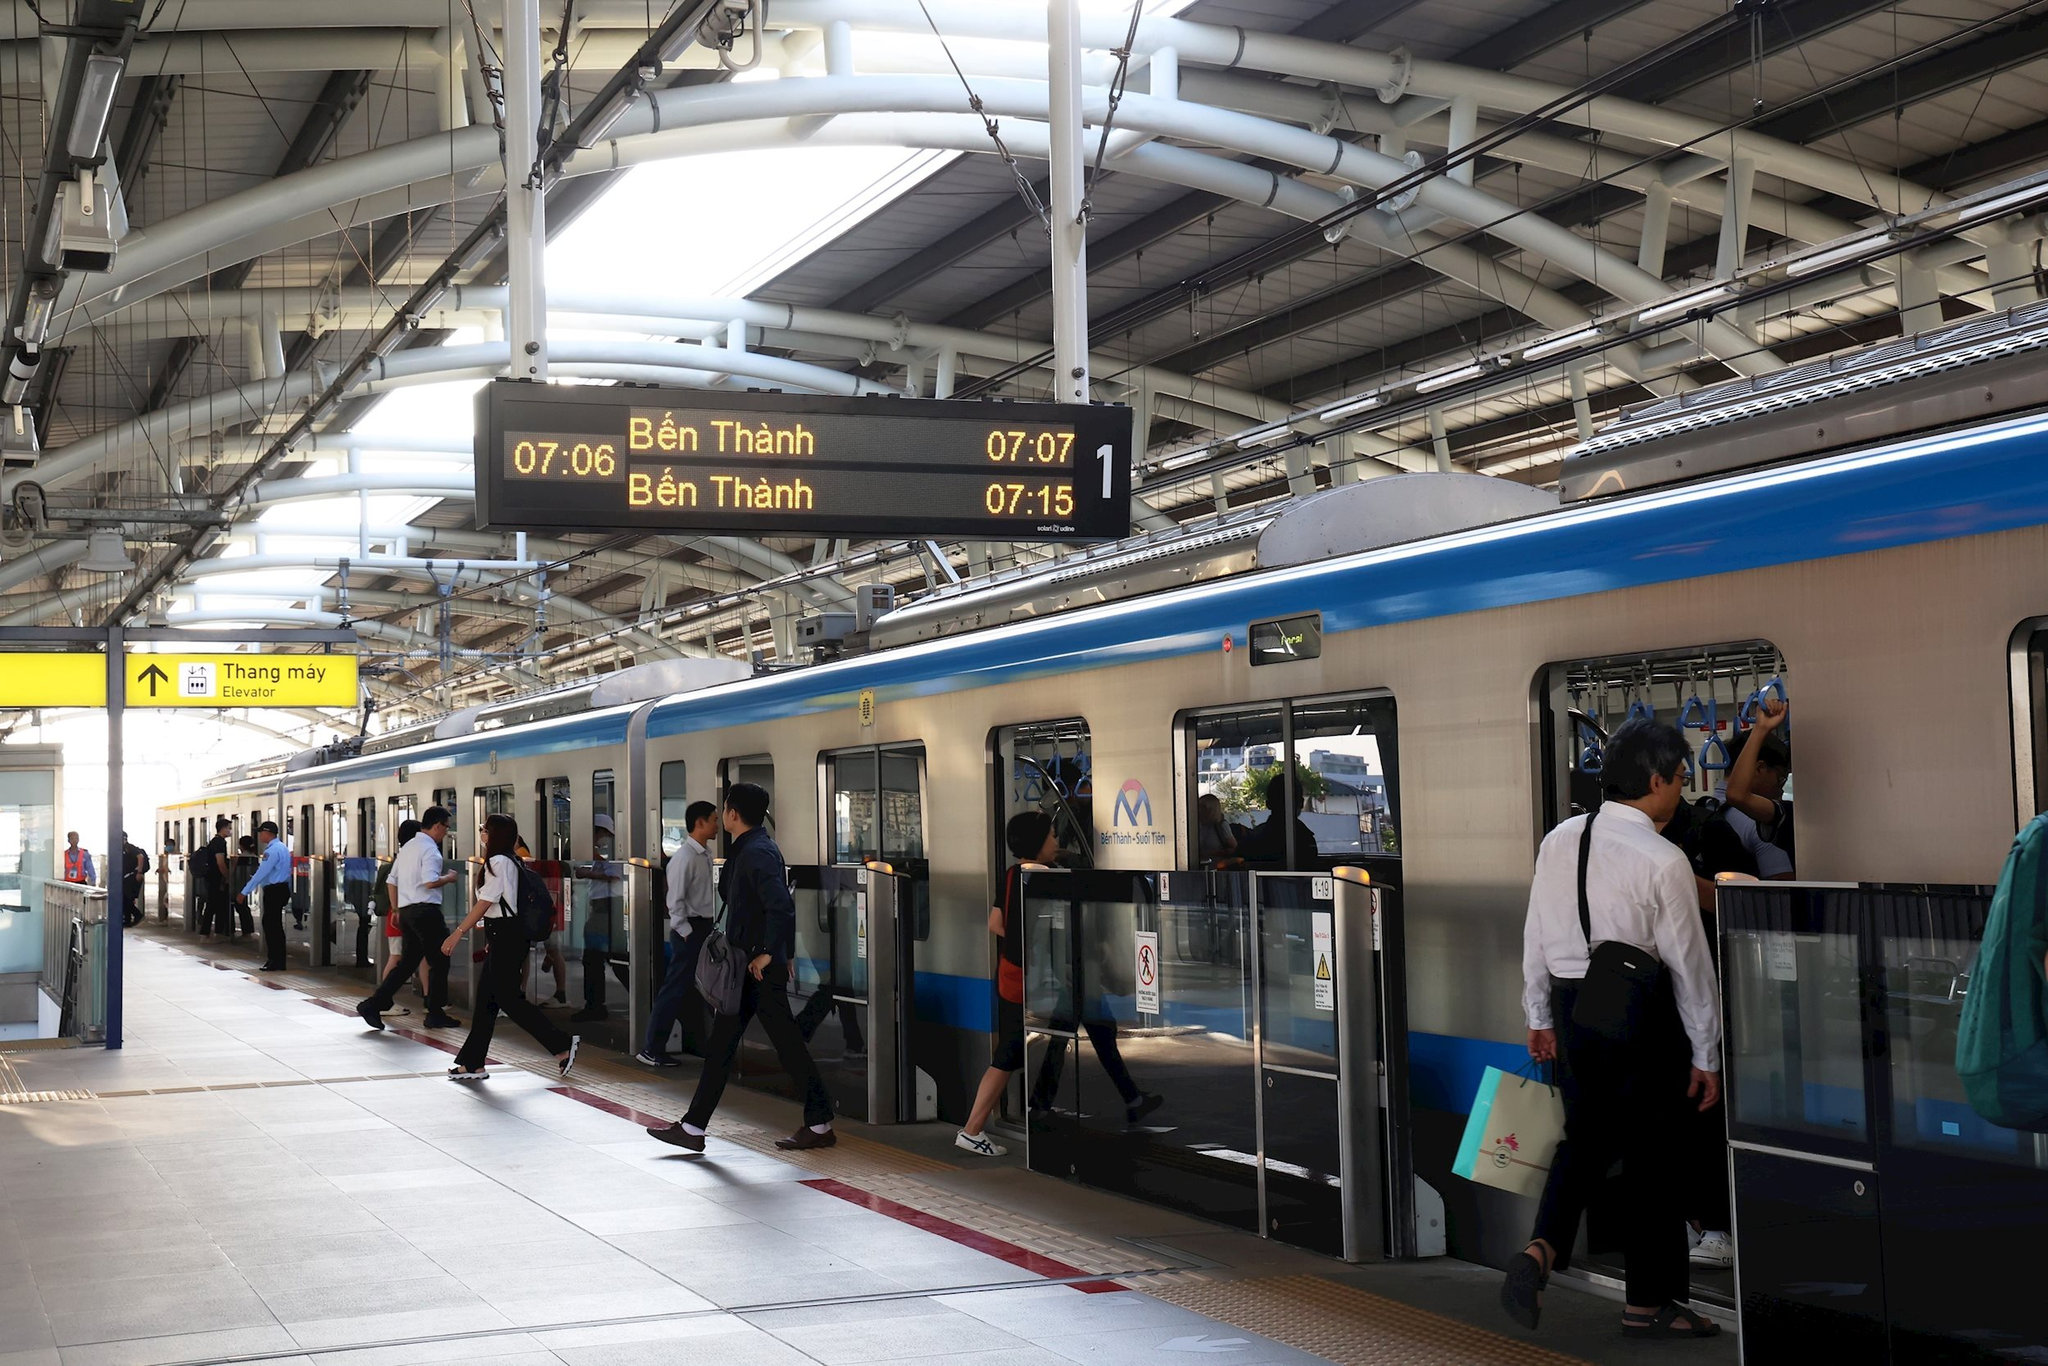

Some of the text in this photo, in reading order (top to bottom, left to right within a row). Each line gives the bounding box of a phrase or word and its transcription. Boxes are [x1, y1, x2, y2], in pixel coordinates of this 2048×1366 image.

[629, 411, 814, 455] Bến Thành
[987, 430, 1075, 463] 07:07
[514, 441, 615, 477] 07:06
[1096, 444, 1113, 499] 1
[628, 466, 813, 510] Bến Thành
[986, 483, 1074, 516] 07:15
[223, 663, 326, 683] Thang máy
[223, 686, 275, 698] Elevator
[1113, 832, 1132, 845] Thành
[1136, 831, 1151, 845] Suối
[1151, 831, 1166, 845] Tiên
